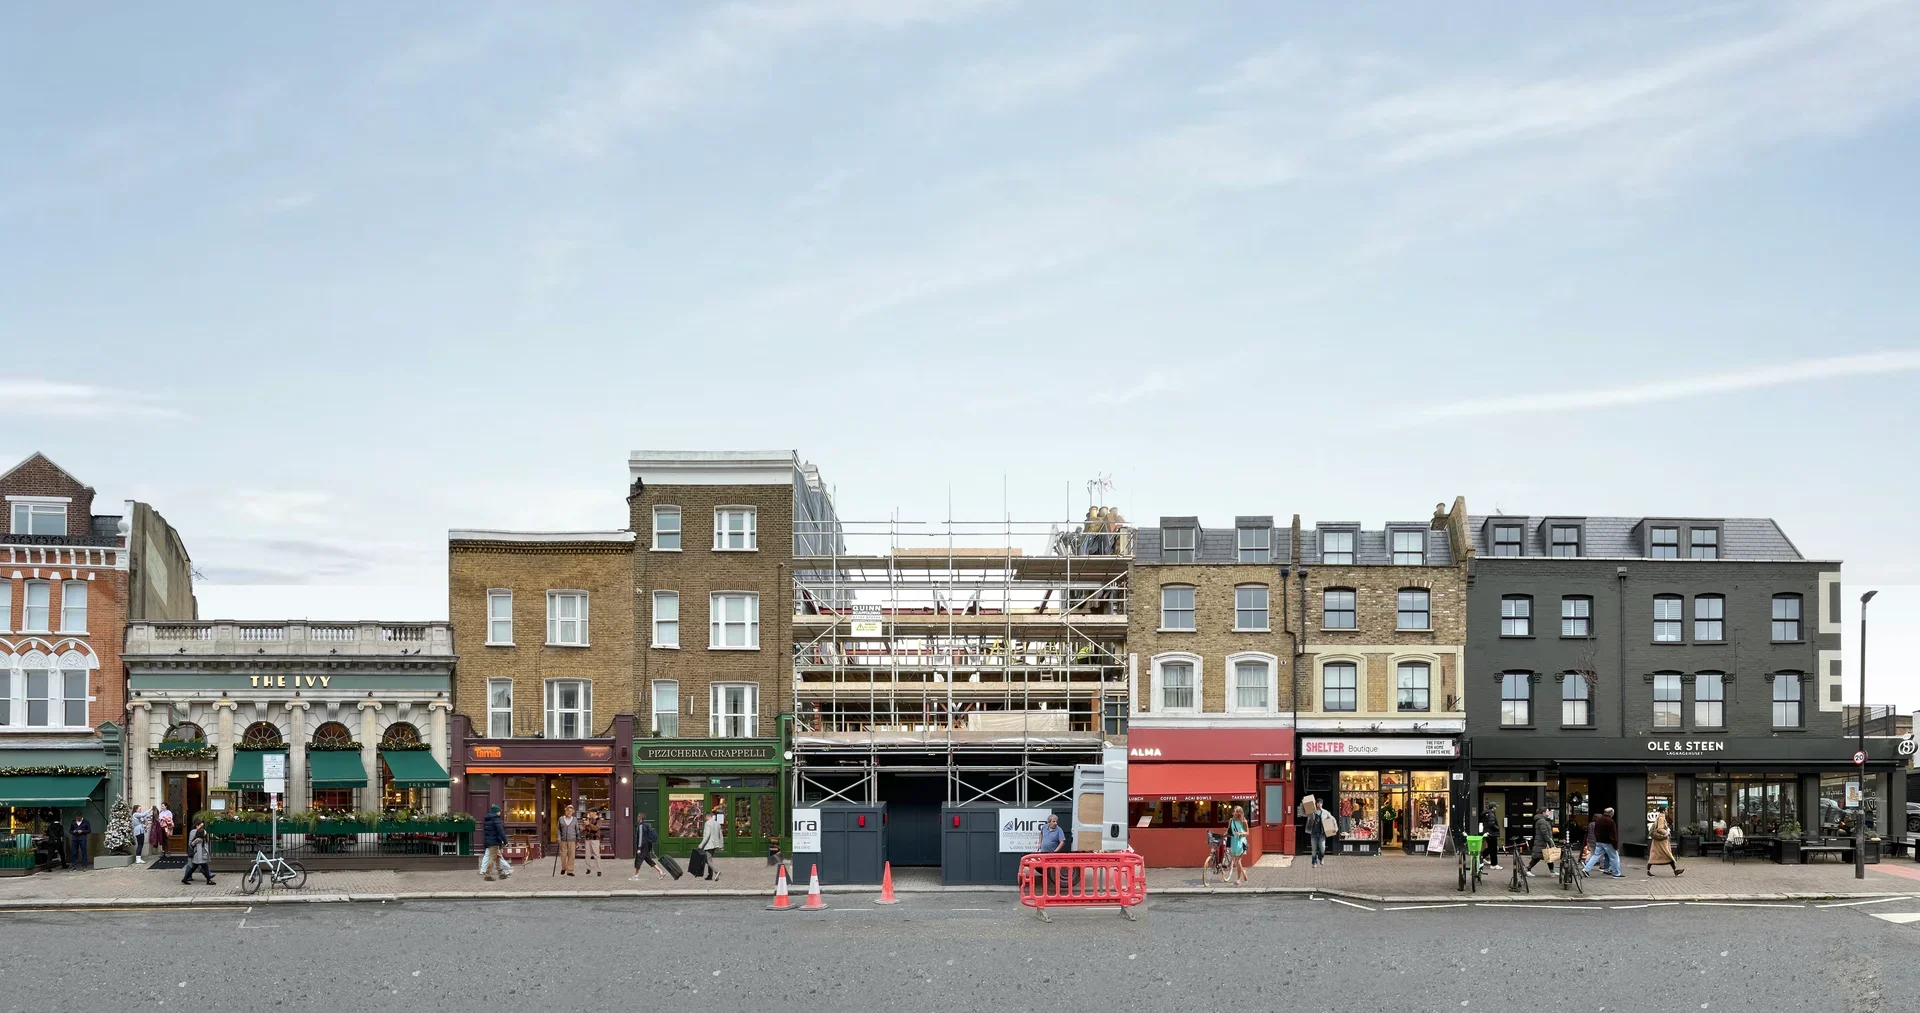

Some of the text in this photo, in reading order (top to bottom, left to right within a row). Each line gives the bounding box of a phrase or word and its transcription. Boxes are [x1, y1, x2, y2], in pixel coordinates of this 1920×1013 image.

[250, 676, 331, 687] THE IVY
[1306, 742, 1379, 753] SHELTER Boutique
[1647, 741, 1724, 751] OLE & STEEN
[474, 747, 502, 758] Tamila
[710, 749, 766, 758] GRAPPELLI
[1130, 748, 1162, 757] ALMA
